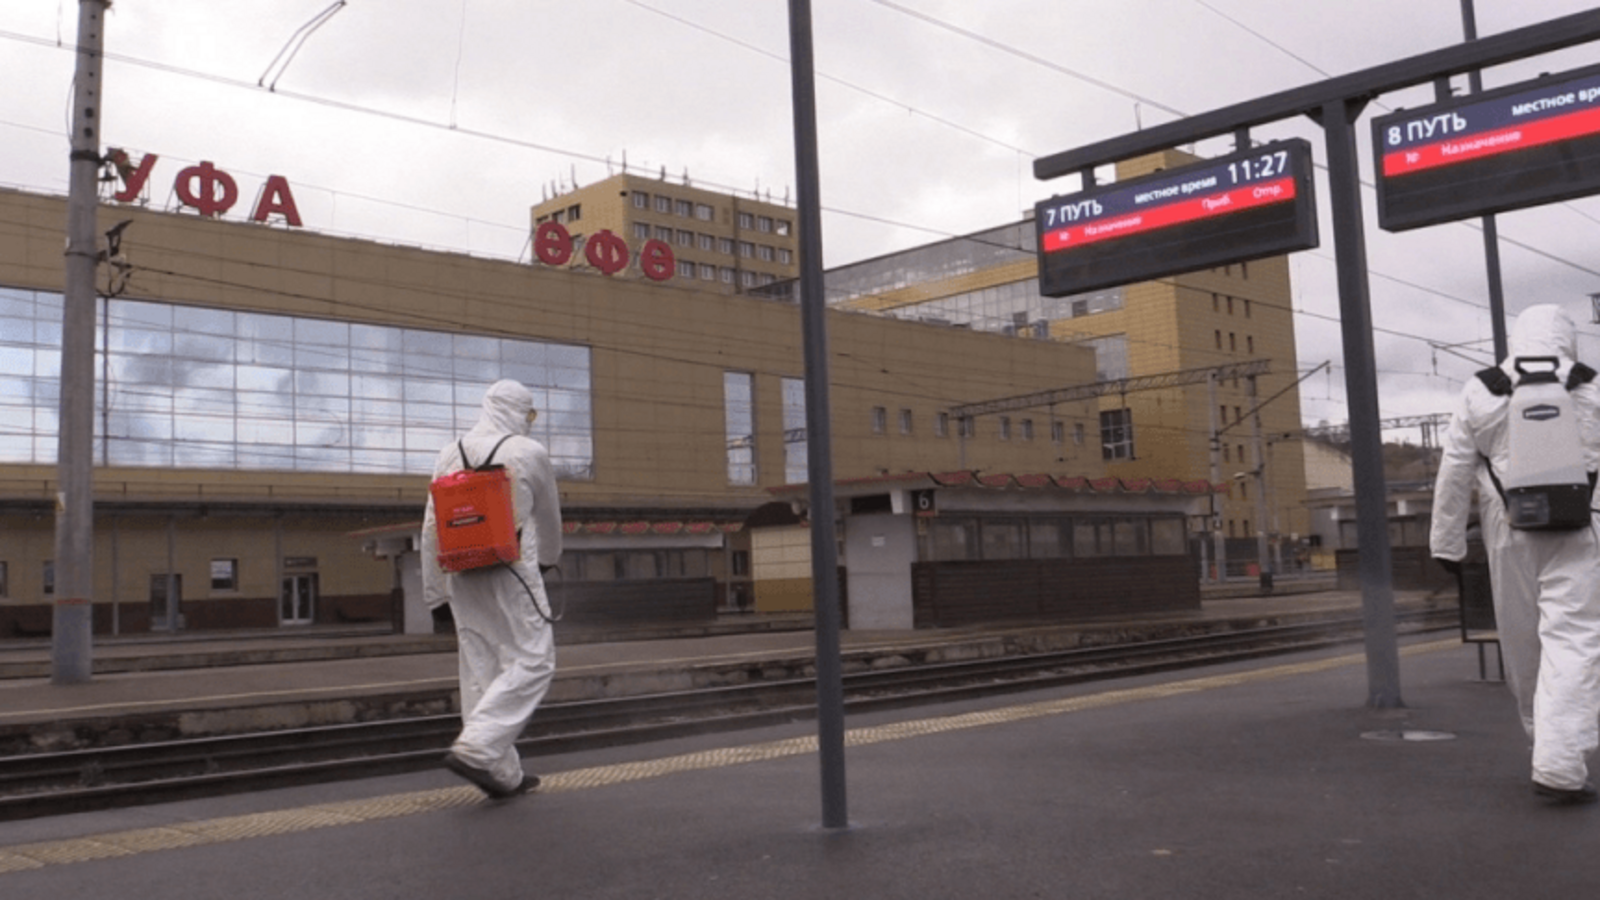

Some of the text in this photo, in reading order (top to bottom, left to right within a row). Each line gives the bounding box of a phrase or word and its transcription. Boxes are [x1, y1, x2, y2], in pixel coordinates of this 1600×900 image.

[1387, 126, 1401, 145] 8
[1407, 112, 1467, 141] ПУТЬ
[1512, 93, 1575, 116] местное
[107, 148, 303, 227] УФА
[1046, 150, 1288, 226] 7 ПУТЬ местное время 11:27
[918, 492, 929, 509] 6
